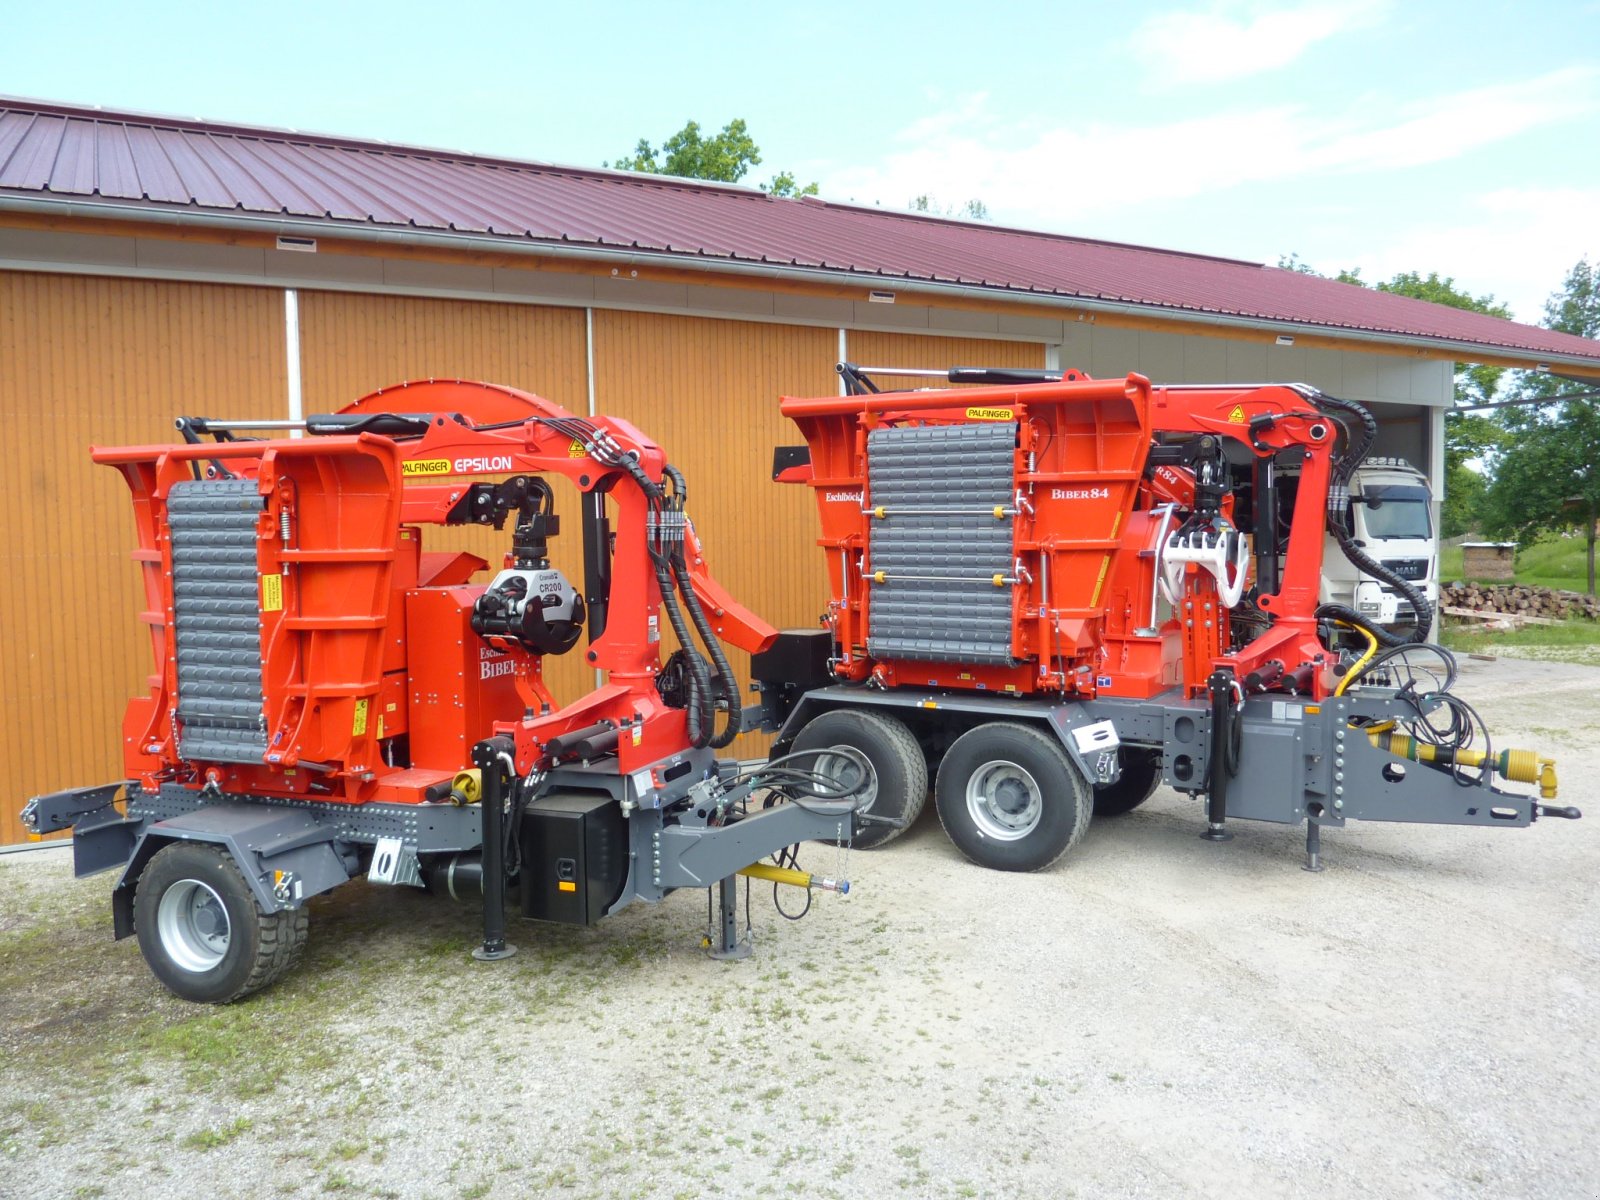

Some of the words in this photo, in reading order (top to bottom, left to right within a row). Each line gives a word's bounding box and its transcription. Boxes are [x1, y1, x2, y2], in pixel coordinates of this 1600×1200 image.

[968, 409, 1011, 419] PALFINGER
[401, 461, 448, 473] ALFINGER
[454, 456, 512, 473] EPSILON
[1090, 488, 1109, 499] 84
[540, 581, 562, 593] CR200
